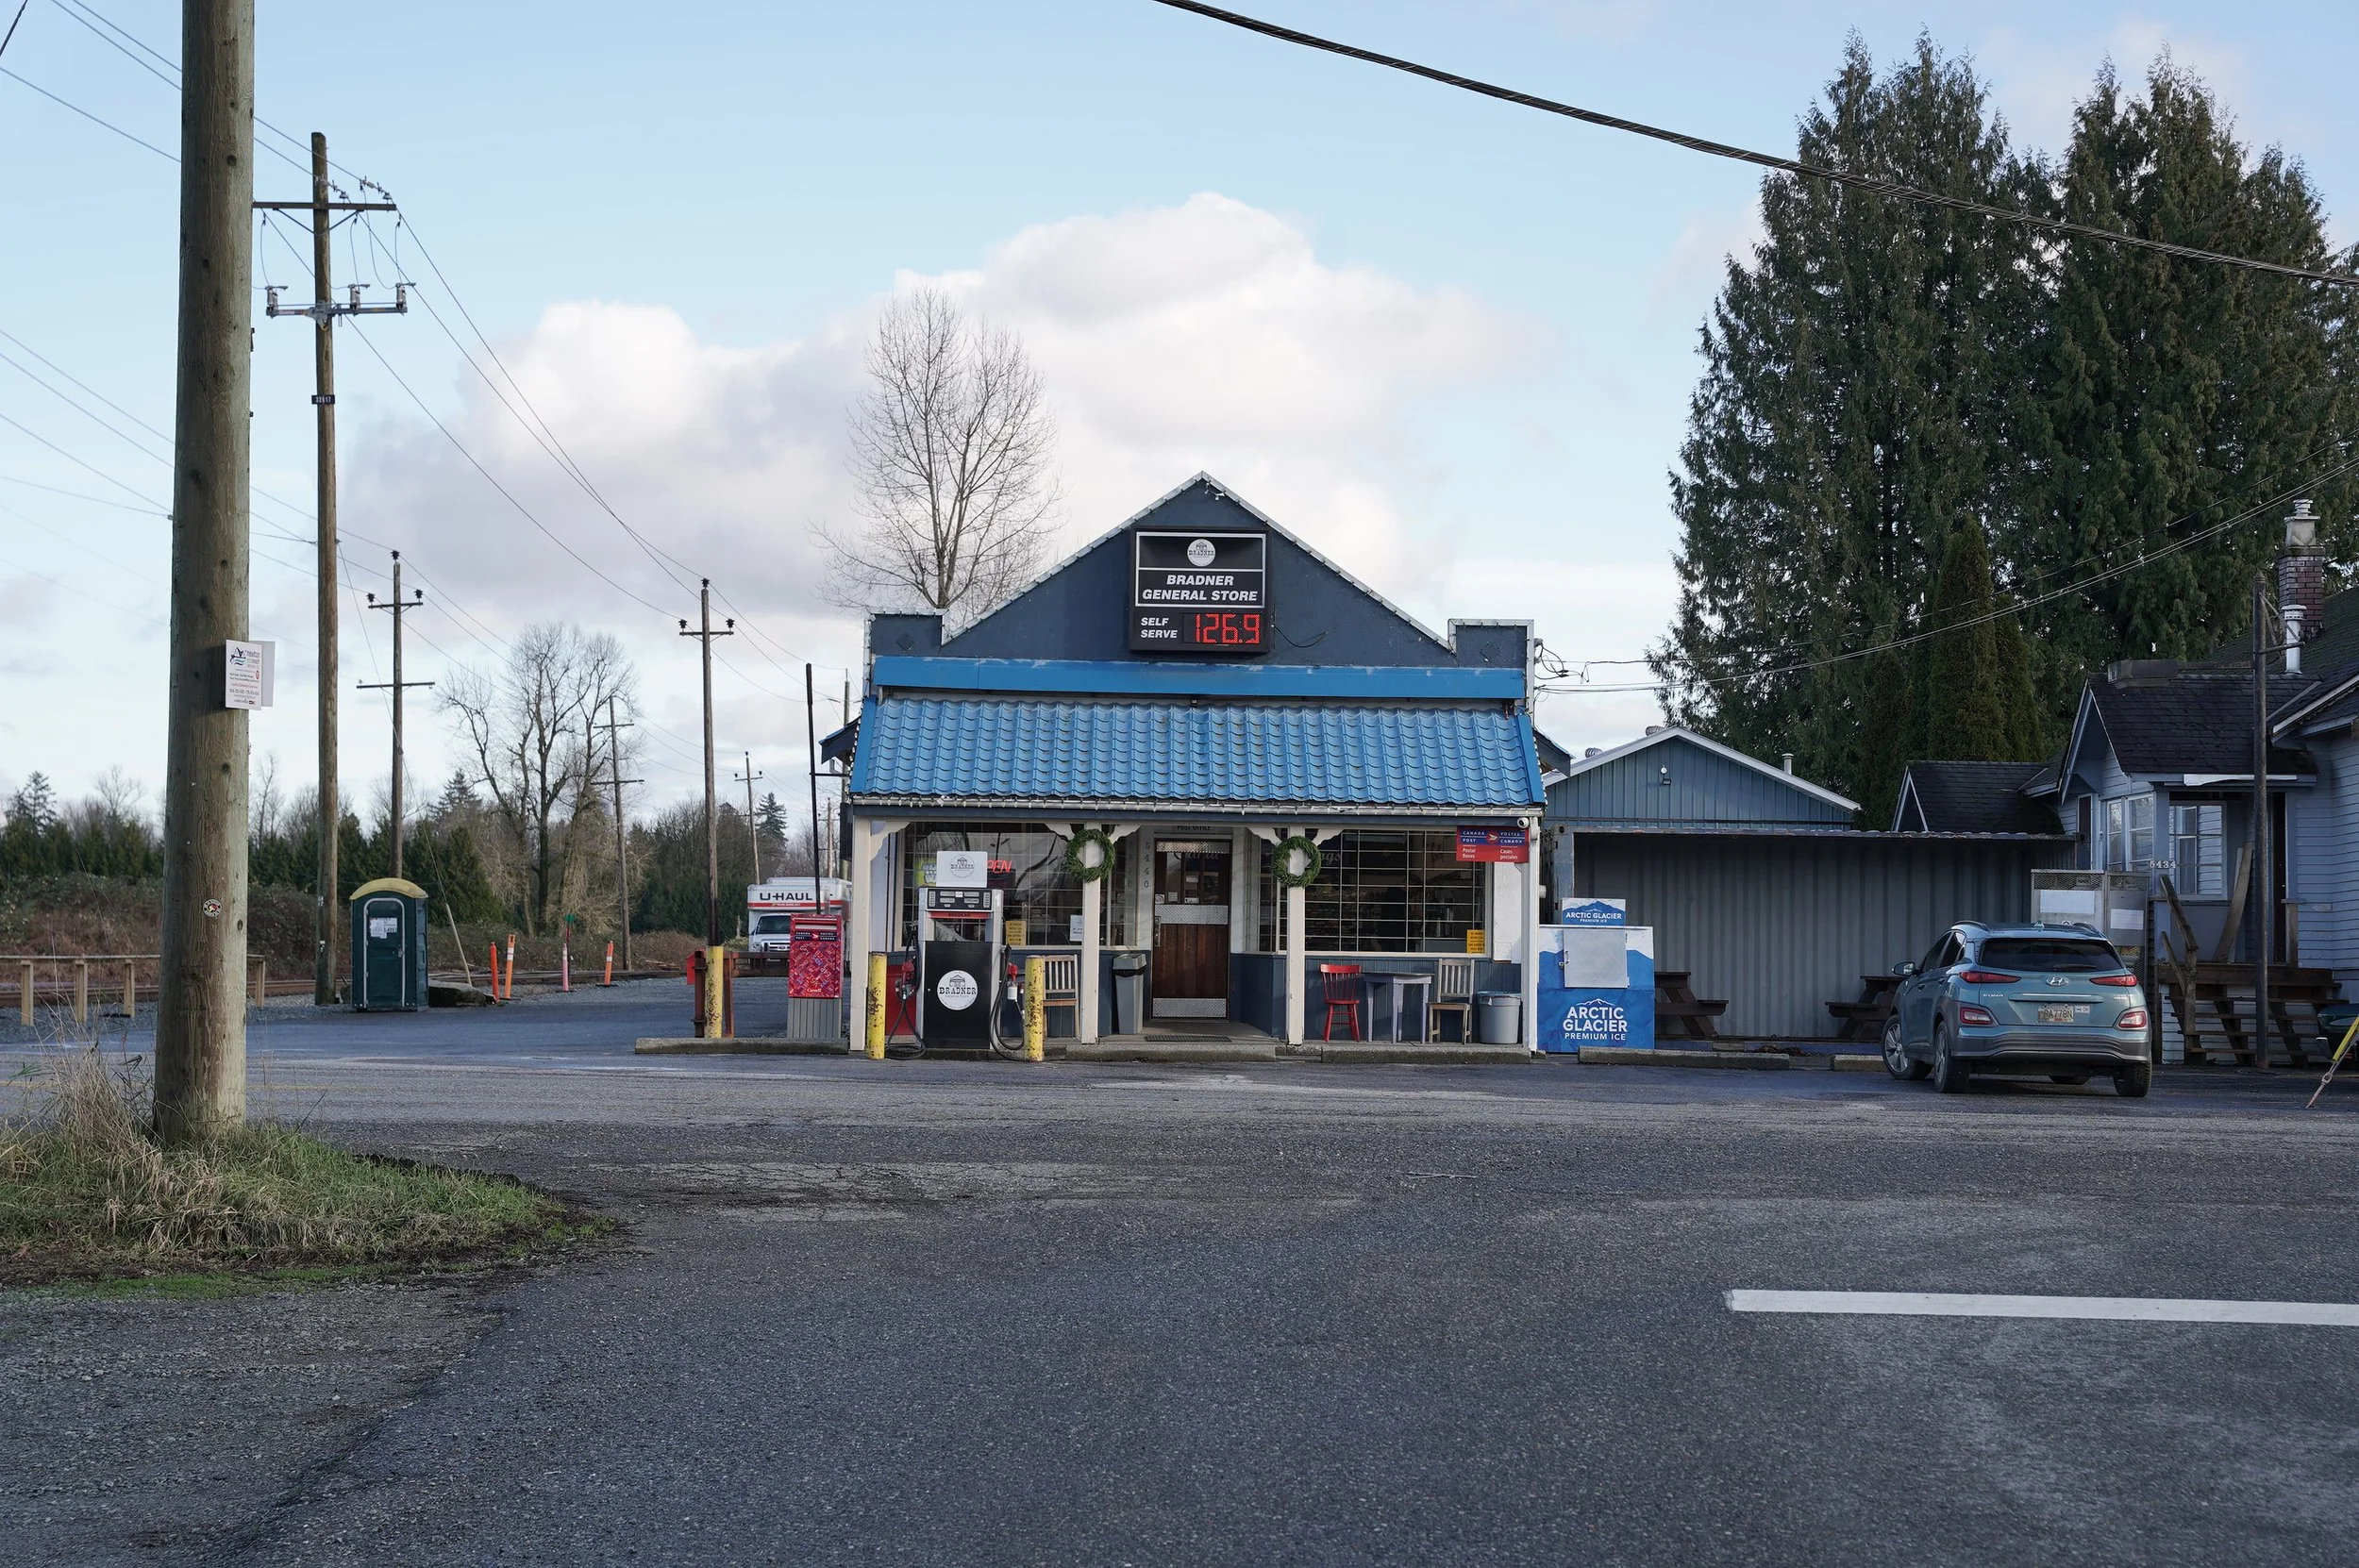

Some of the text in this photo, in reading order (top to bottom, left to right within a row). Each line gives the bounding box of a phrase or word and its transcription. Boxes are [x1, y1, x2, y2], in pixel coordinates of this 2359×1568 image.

[1166, 575, 1233, 586] BRADNER
[1142, 590, 1258, 601] GENERAL STORE
[1141, 617, 1169, 626] SELF
[1141, 629, 1178, 638] SERVE
[1195, 613, 1260, 644] 126.9
[2149, 860, 2177, 869] 5434
[760, 892, 812, 901] U-HAUL
[1566, 1007, 1624, 1020] ARCTIC
[1563, 1019, 1628, 1032] GLACIER
[1564, 1032, 1608, 1041] PREMIUM
